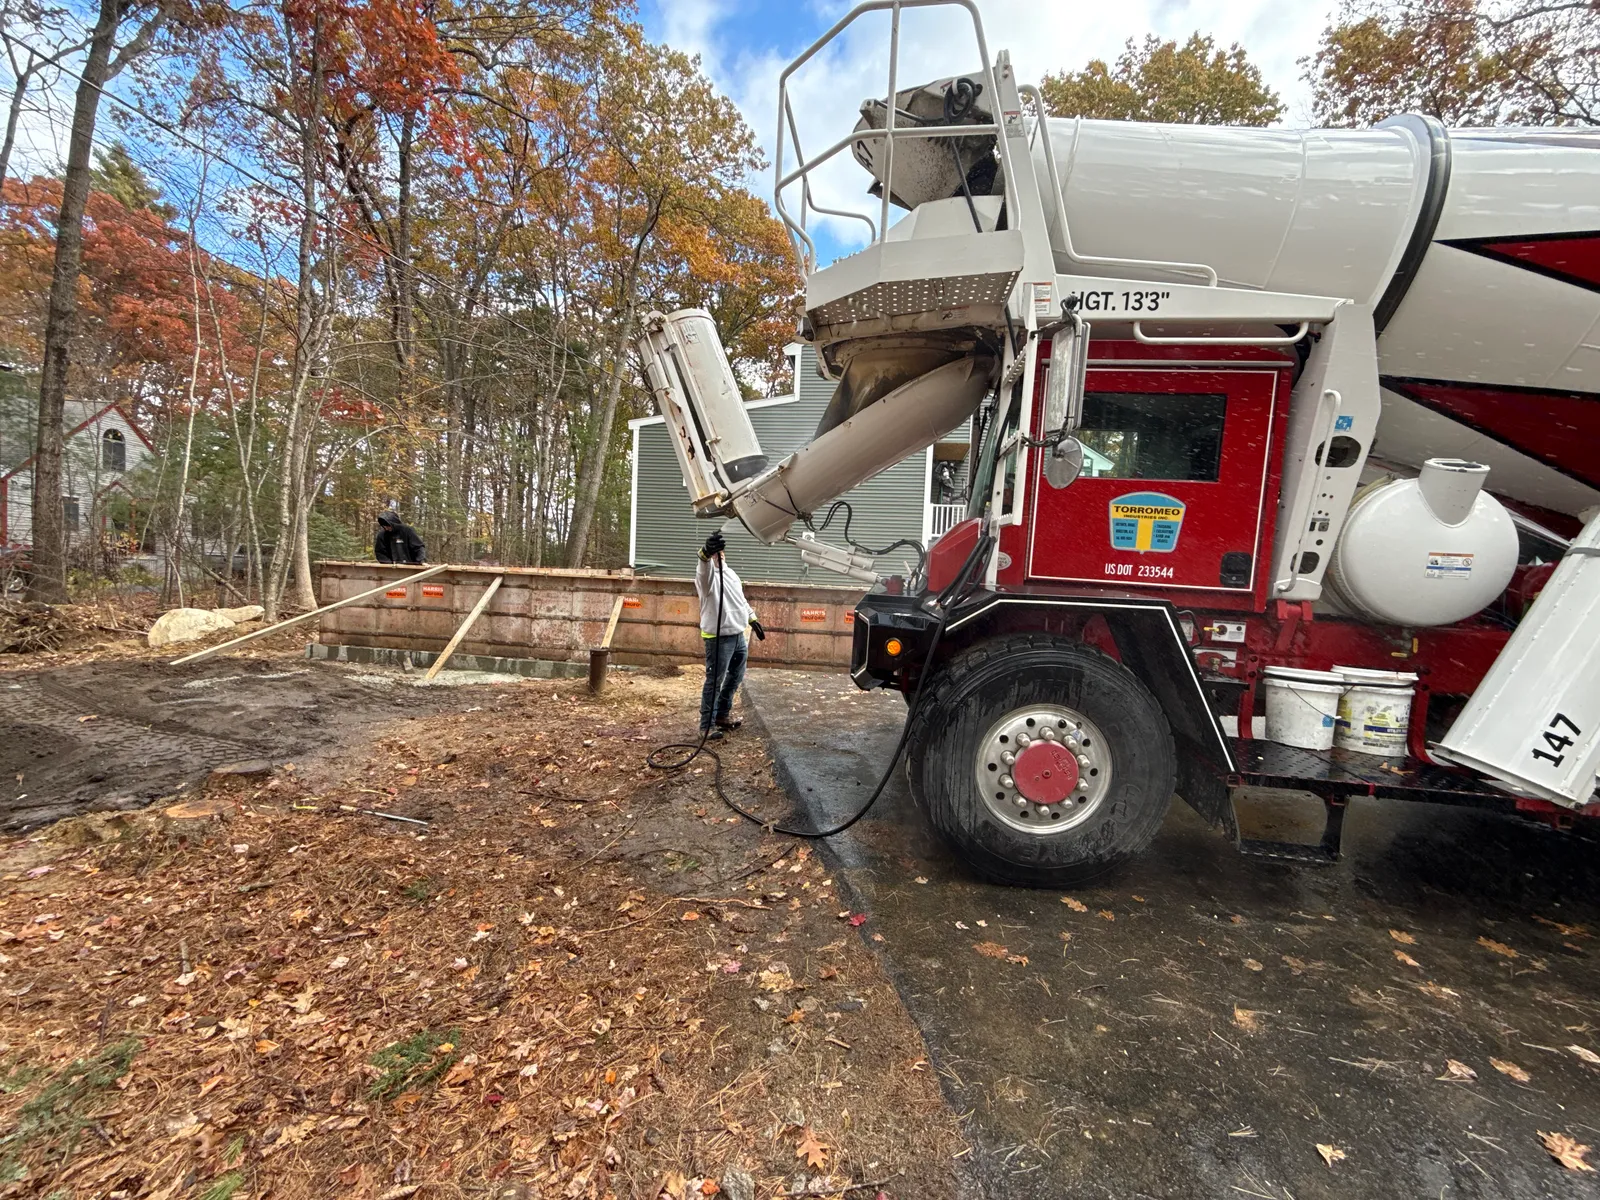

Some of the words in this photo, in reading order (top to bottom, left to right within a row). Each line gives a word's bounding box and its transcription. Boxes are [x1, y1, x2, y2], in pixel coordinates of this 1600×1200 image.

[1072, 291, 1116, 311] HGT.
[1121, 291, 1170, 311] 13'3"
[1114, 506, 1180, 516] TORROMEO
[1104, 563, 1116, 575] US
[1117, 564, 1134, 576] DOT
[1138, 565, 1174, 578] 233544
[1531, 712, 1582, 768] 147
